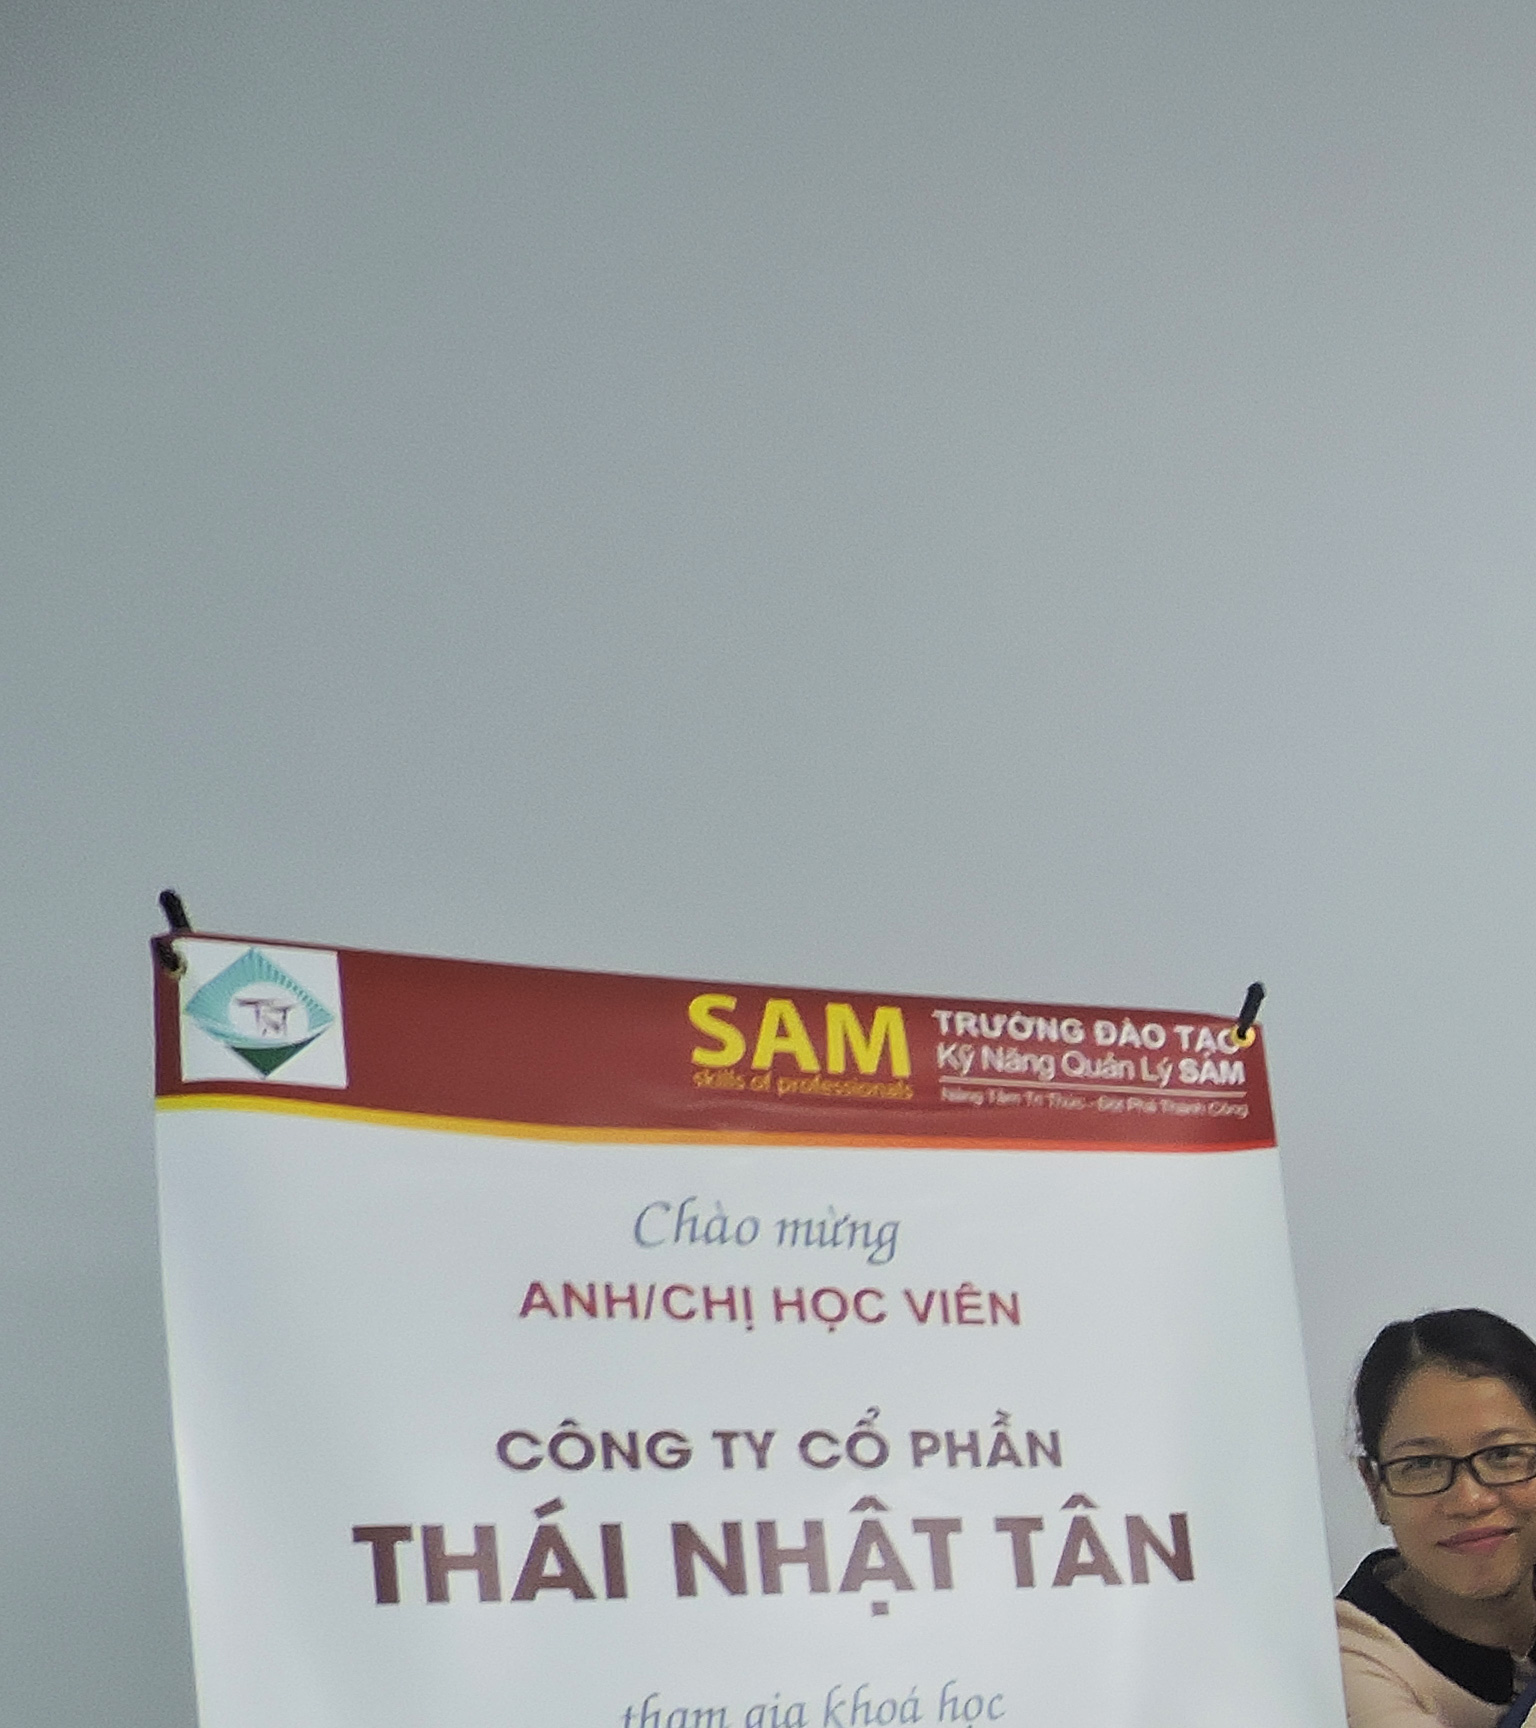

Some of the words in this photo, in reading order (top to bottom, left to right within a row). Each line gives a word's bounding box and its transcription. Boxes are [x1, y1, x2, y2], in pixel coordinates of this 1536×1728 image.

[688, 993, 911, 1078] SAM
[931, 1009, 1085, 1044] TRƯỜNG
[1093, 1017, 1166, 1050] ĐÀO
[750, 1071, 771, 1092] of
[776, 1074, 913, 1099] professionals
[1141, 1056, 1173, 1088] Lý
[1178, 1057, 1245, 1085] SAM
[633, 1196, 760, 1249] Chào
[776, 1204, 900, 1266] mừng
[519, 1281, 754, 1332] ANH/CHỊ
[773, 1286, 886, 1333] HỌC
[904, 1281, 1022, 1326] VIÊN
[494, 1418, 692, 1471] CÔNG
[711, 1429, 775, 1470] TY
[799, 1406, 889, 1470] CỔ
[910, 1409, 1063, 1468] PHẦN
[352, 1497, 629, 1605] THÁI
[670, 1494, 963, 1617] NHẬT
[995, 1492, 1197, 1590] TÂN
